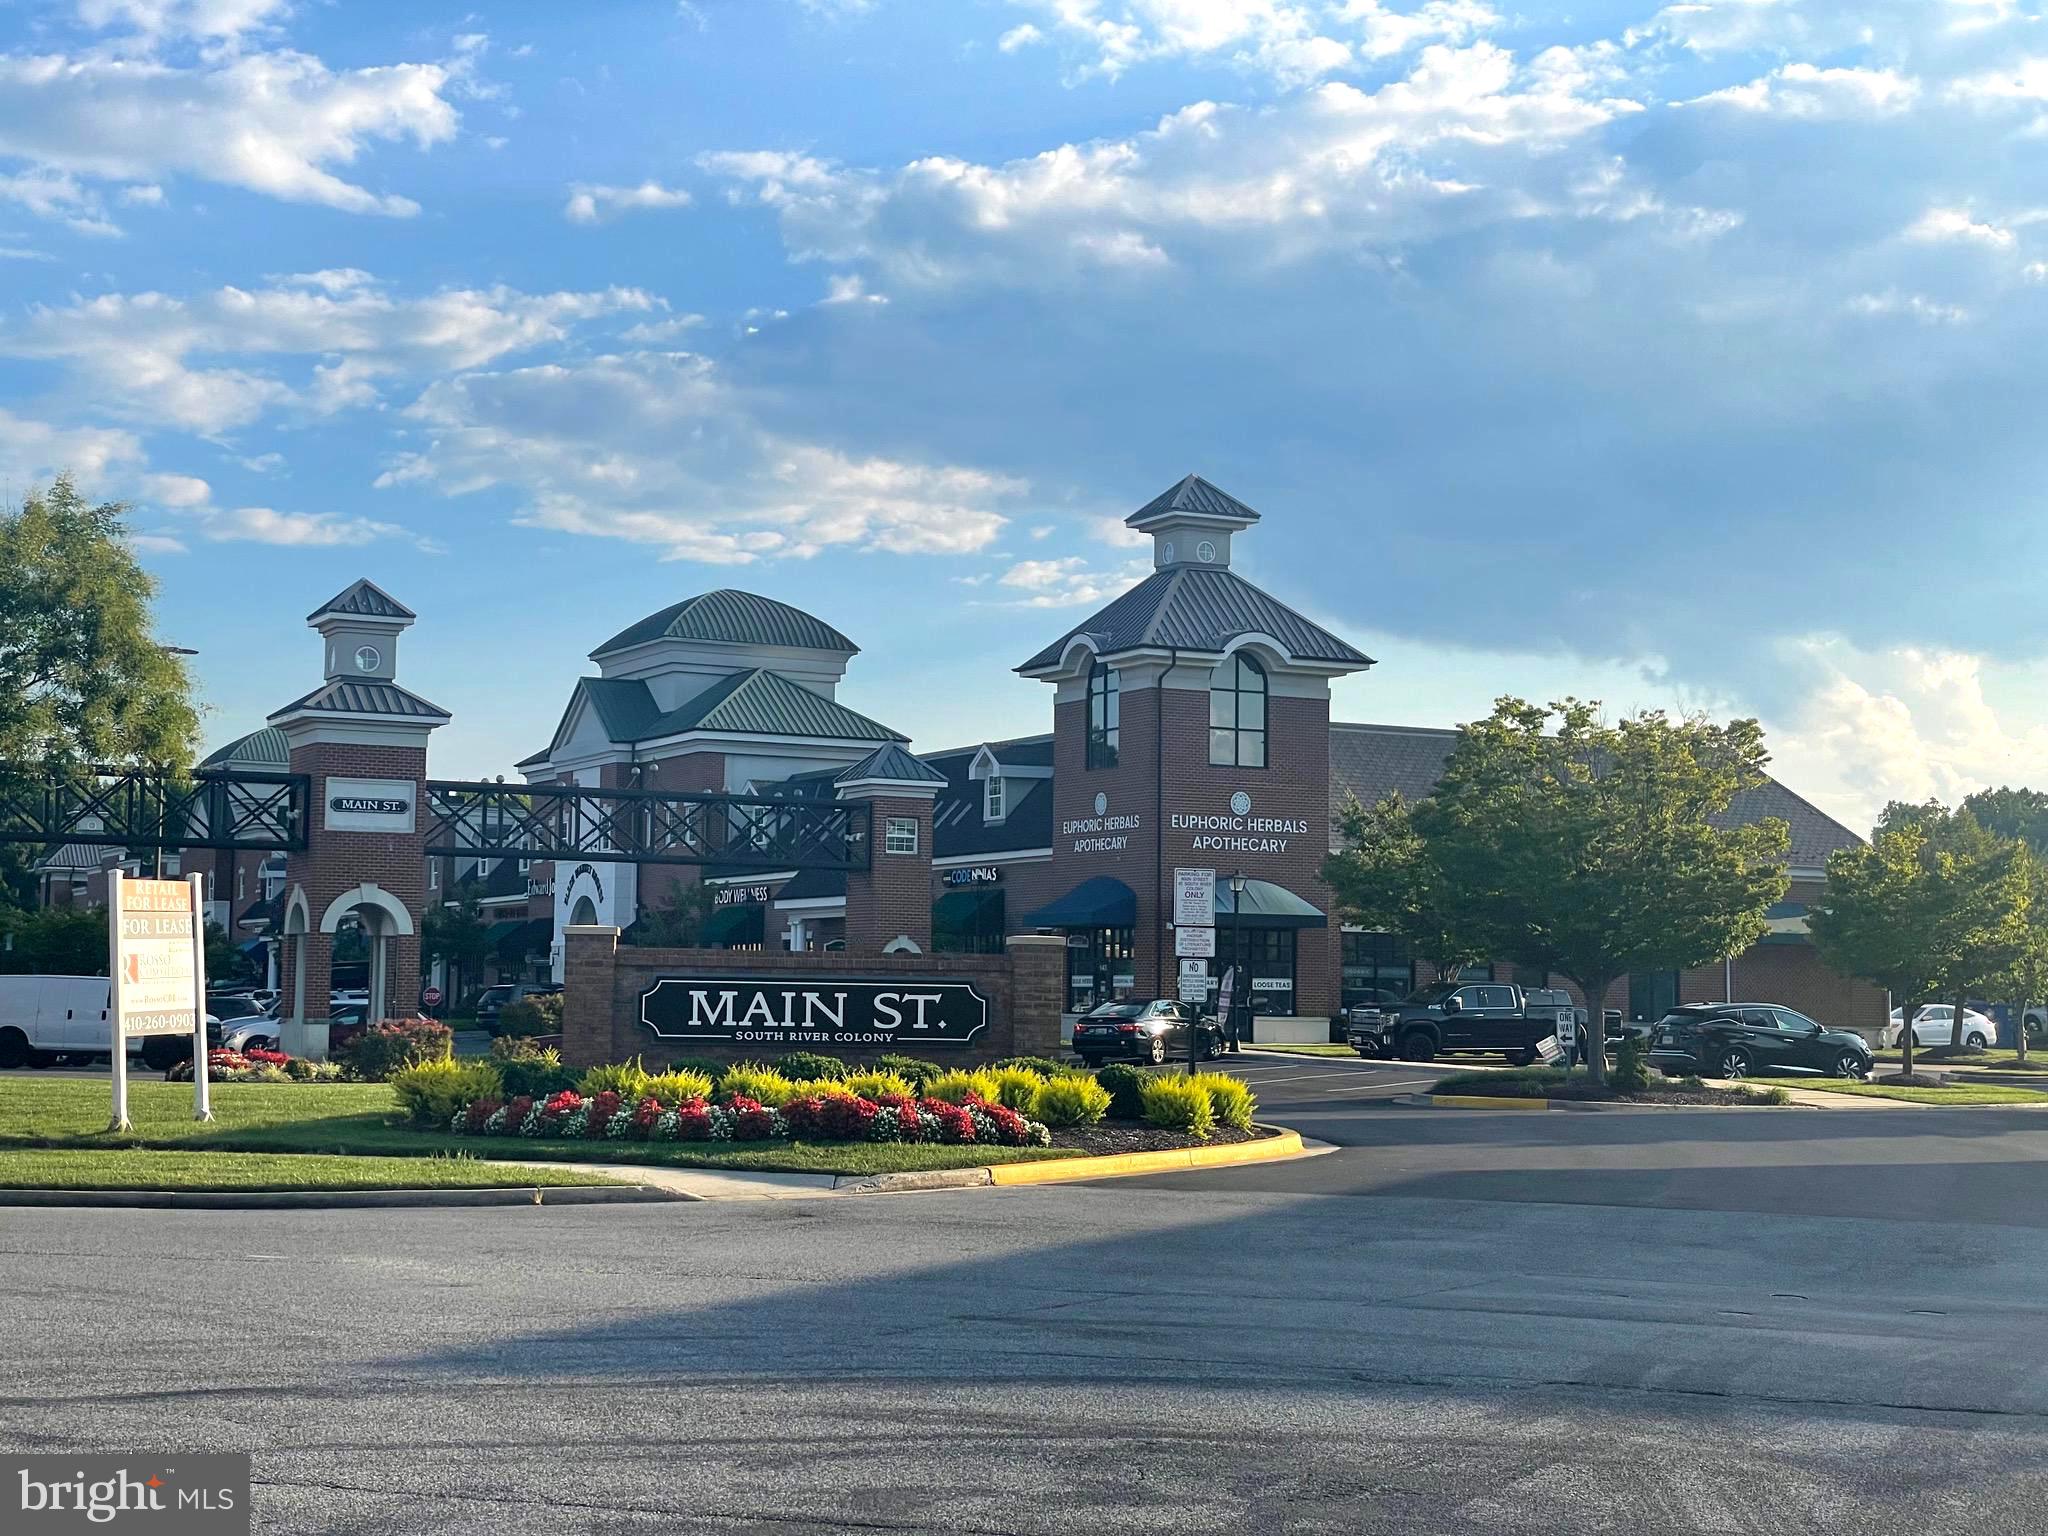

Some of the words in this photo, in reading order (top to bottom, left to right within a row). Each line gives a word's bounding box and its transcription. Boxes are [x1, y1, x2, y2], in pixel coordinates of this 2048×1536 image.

[342, 800, 378, 809] MAIN
[383, 801, 400, 811] ST.
[1063, 818, 1103, 834] EUPHORIC
[1104, 815, 1140, 830] HERBALS
[1171, 814, 1243, 831] EUPHORIC
[1247, 818, 1308, 833] HERBALS
[1073, 836, 1128, 852] APOTHECARY
[1192, 836, 1288, 852] APOTHECARY
[951, 869, 970, 883] CODE
[135, 880, 178, 896] RETAIL
[528, 877, 548, 896] Edward
[1184, 891, 1205, 899] ONLY
[126, 896, 151, 910] FOR
[153, 897, 187, 911] LEASE
[123, 919, 150, 934] FOR
[155, 918, 193, 934] LEASE
[1189, 962, 1199, 972] NO
[425, 992, 440, 1000] STOP
[688, 989, 848, 1027] MAIN
[873, 992, 948, 1029] ST.
[1559, 1012, 1572, 1022] ONE
[1559, 1023, 1573, 1033] WAY
[735, 1031, 784, 1041] SOUTH
[789, 1031, 830, 1041] RIVER
[834, 1032, 894, 1042] COLONY
